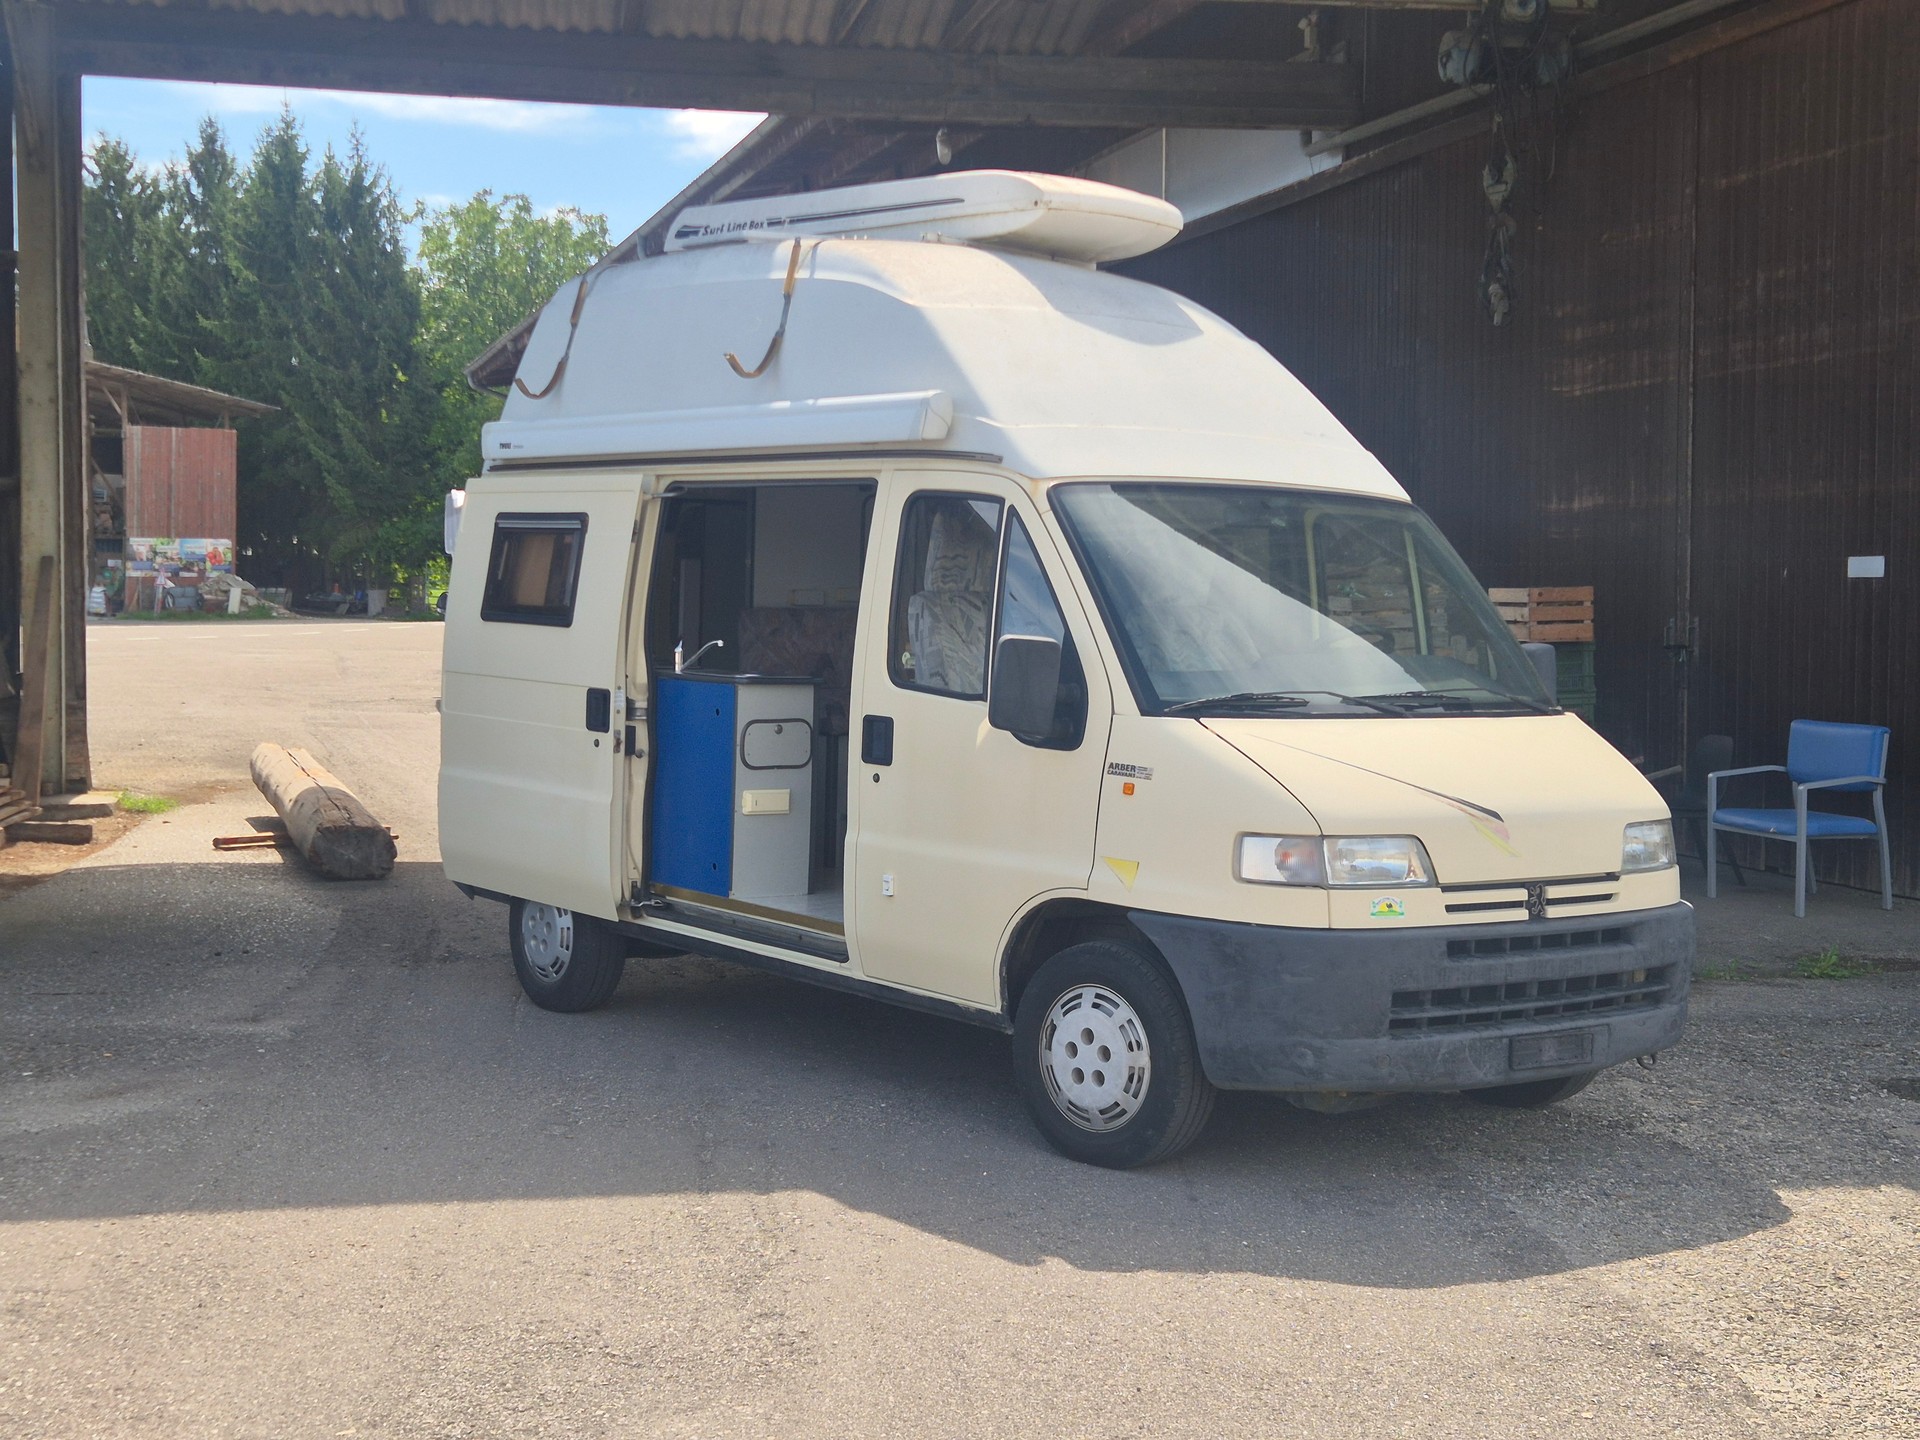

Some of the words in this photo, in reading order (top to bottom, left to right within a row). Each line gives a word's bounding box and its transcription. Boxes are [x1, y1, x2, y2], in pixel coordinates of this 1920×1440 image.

[702, 225, 725, 236] Surf
[727, 221, 748, 232] Line
[749, 220, 764, 230] Box
[1108, 762, 1136, 773] ARBER
